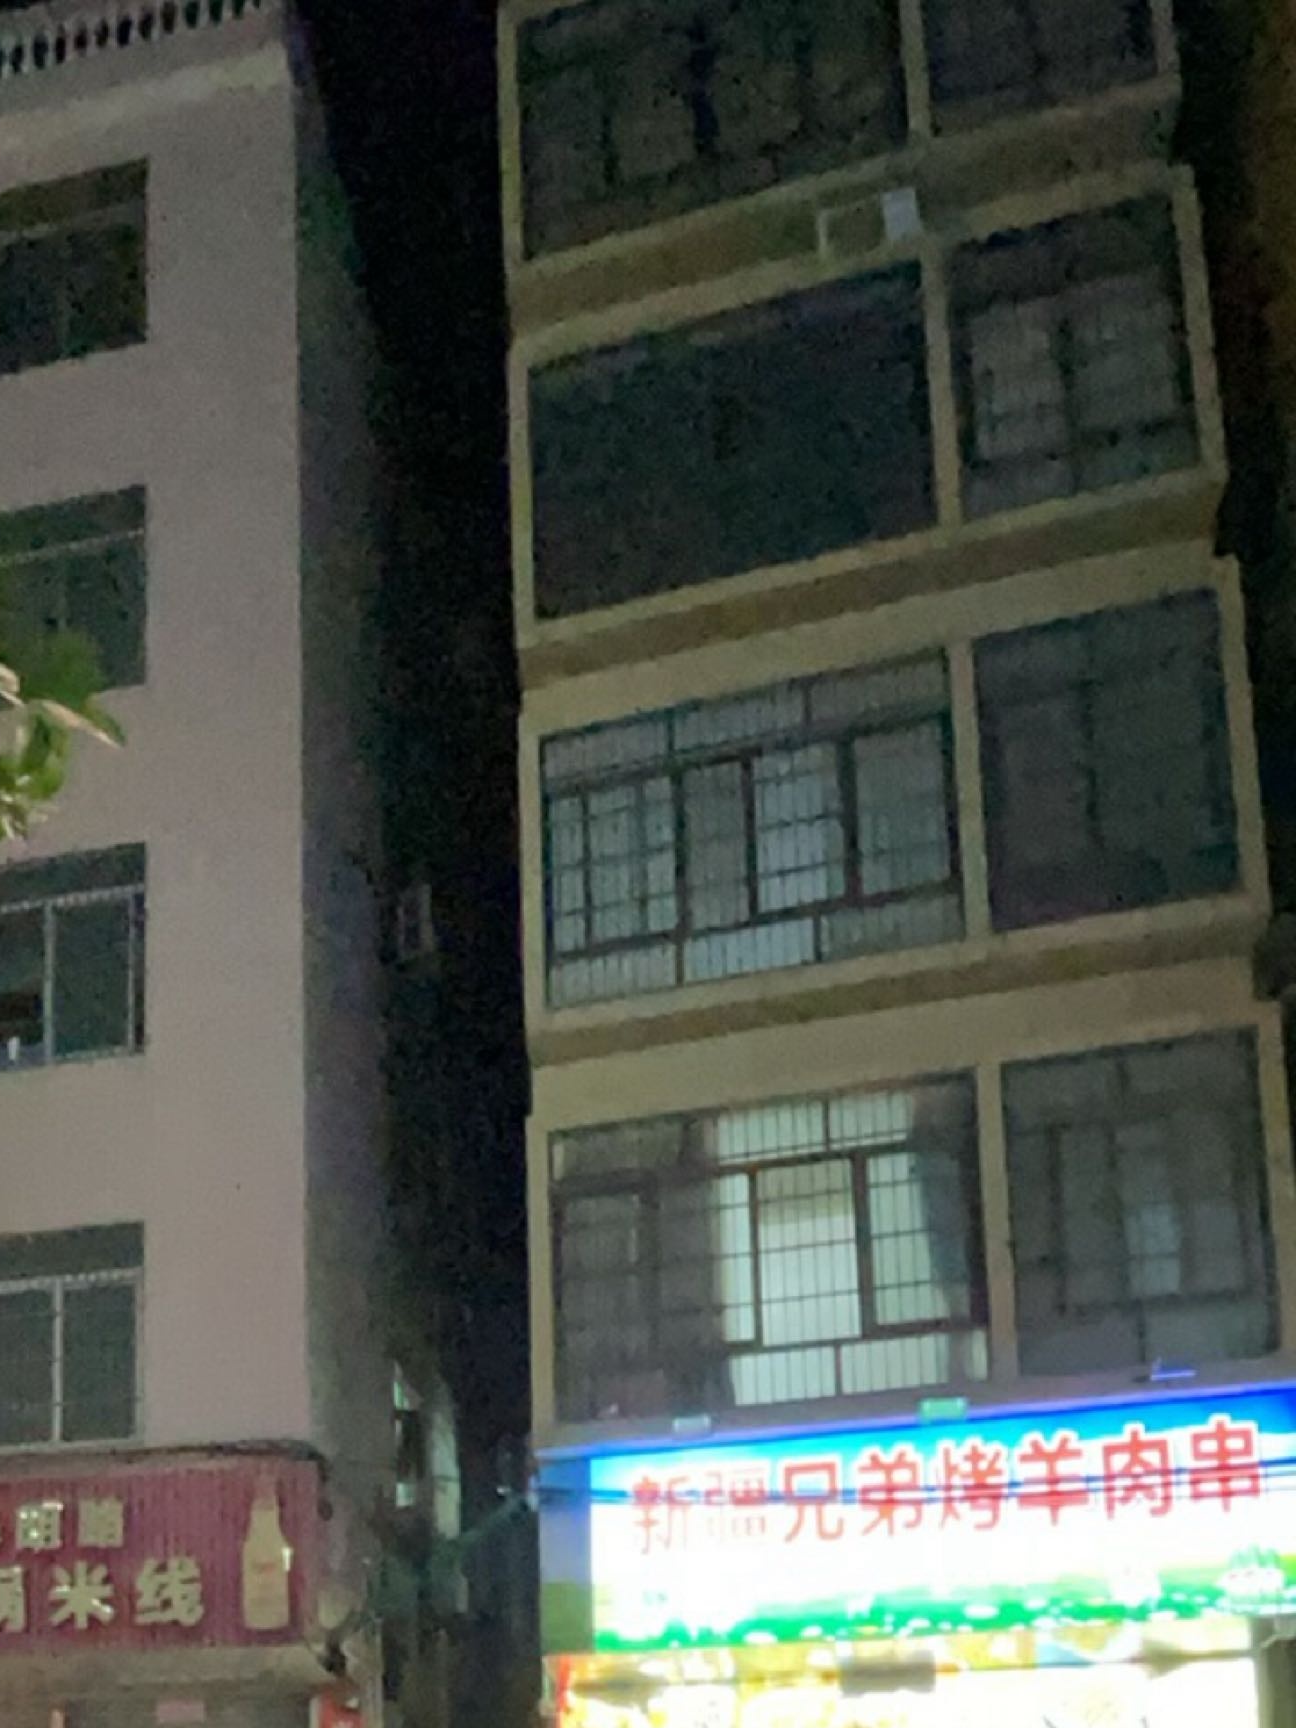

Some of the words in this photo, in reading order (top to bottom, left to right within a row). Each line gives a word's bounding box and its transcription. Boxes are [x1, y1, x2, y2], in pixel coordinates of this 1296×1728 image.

[630, 1415, 1264, 1555] 新疆兄弟烤羊肉串
